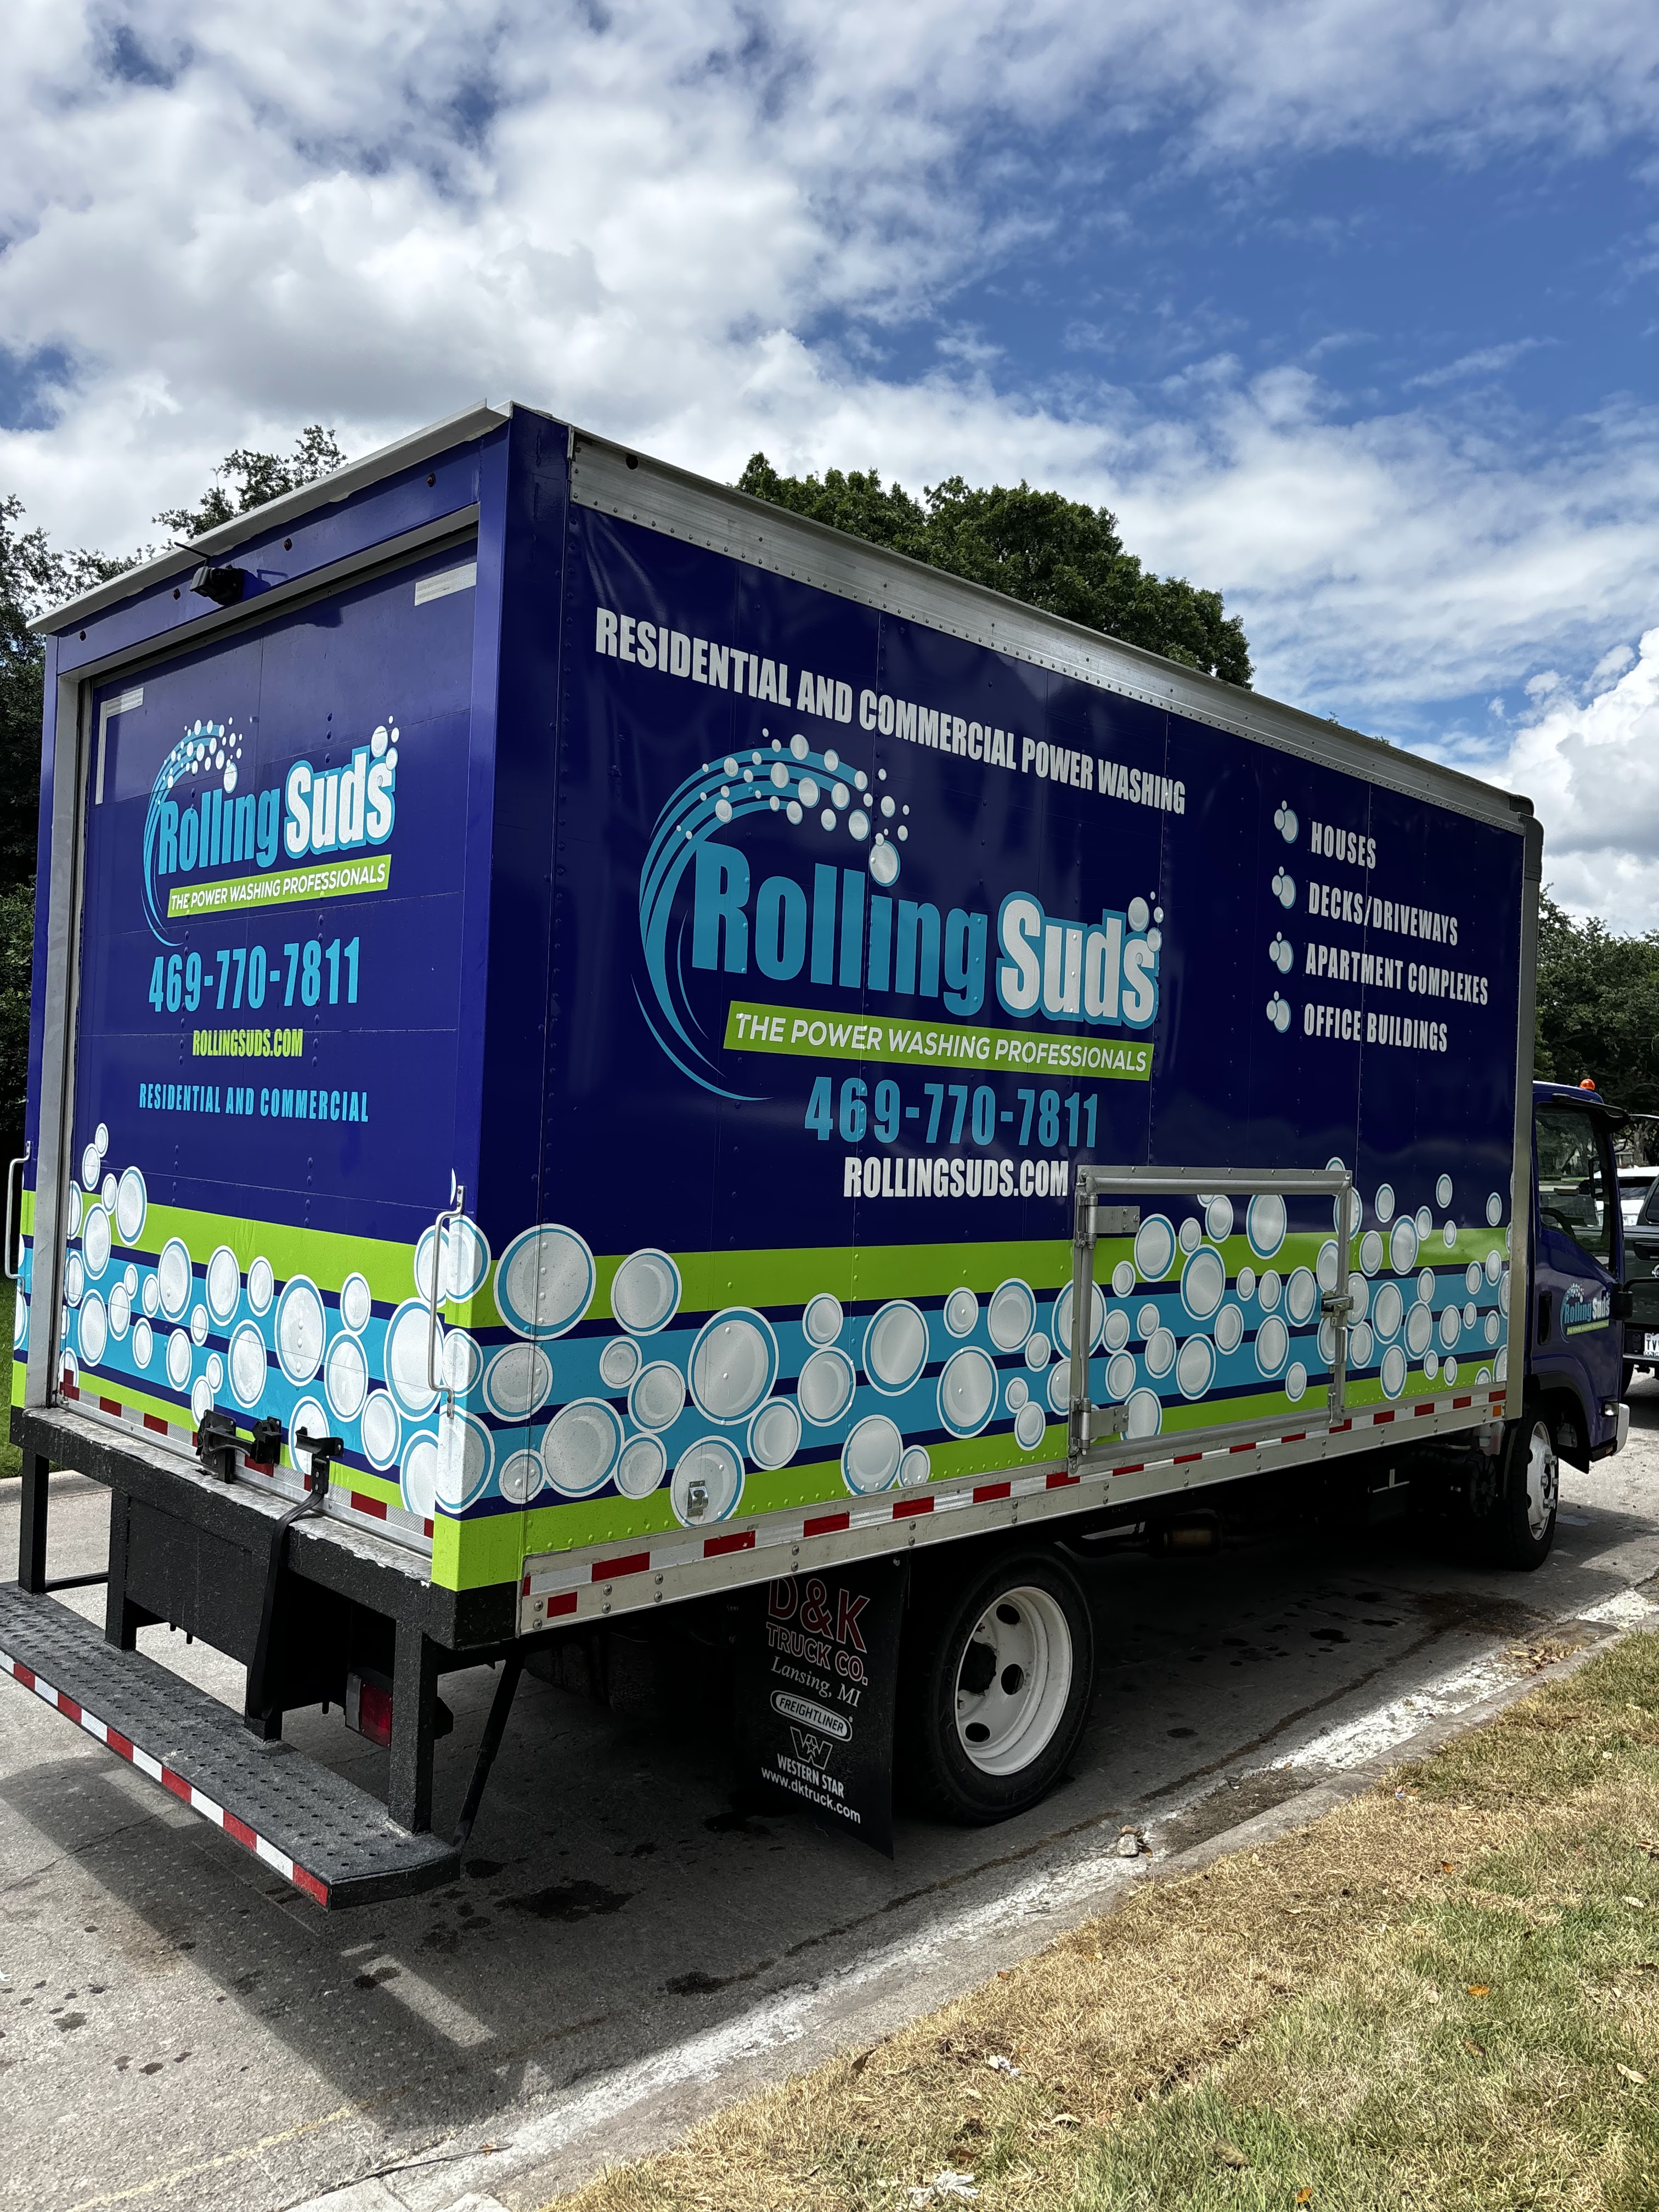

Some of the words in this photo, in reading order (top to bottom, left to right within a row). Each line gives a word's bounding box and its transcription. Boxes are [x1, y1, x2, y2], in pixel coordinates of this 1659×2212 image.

[596, 607, 791, 707] RESIDENTIAL
[797, 670, 853, 724] AND
[859, 689, 1017, 770] COMMERCIAL
[1022, 736, 1093, 791] POWER
[1098, 759, 1185, 815] WASHING
[158, 788, 280, 875] Rolling
[285, 749, 394, 857] Suds
[1311, 821, 1376, 869] HOUSES
[171, 894, 190, 911] THE
[190, 889, 227, 908] POWER
[230, 879, 280, 905] WASHING
[283, 863, 386, 895] PROFESSIONALS
[692, 840, 988, 1016] Rolling
[998, 894, 1158, 1026] Suds
[1308, 882, 1458, 946] DECKS/DRIVEWAYS
[149, 936, 359, 1012] 469-770-7811
[1305, 943, 1403, 990] APARTMENT
[1408, 962, 1488, 1005] COMPLEXES
[192, 1028, 303, 1057] ROLLINGSUDS.COM
[736, 1013, 786, 1043] THE
[791, 1020, 882, 1052] POWER
[888, 1028, 990, 1060] WASHING
[995, 1039, 1147, 1071] PROFESSIONALS
[1304, 1003, 1361, 1041] OFFICE
[1367, 1012, 1447, 1052] BUILDINGS
[139, 1083, 221, 1113] RESIDENTIAL
[225, 1087, 255, 1115] AND
[260, 1088, 368, 1122] COMMERCIAL
[804, 1076, 1098, 1148] 469-770-7811
[843, 1156, 1069, 1198] ROLLINGSUDS.COM
[1564, 1301, 1592, 1324] Rolling
[1592, 1296, 1611, 1321] Suds
[1646, 1339, 1659, 1351] TV
[766, 1622, 832, 1671] TRUCK
[835, 1650, 868, 1686] CO.
[771, 1656, 832, 1697] Lansing,
[837, 1683, 861, 1707] MI
[779, 1697, 844, 1733] FREIGHTLINER
[761, 1767, 861, 1824] www.dktruck.com
[777, 1753, 820, 1786] WESTERN
[822, 1774, 844, 1798] STAR
